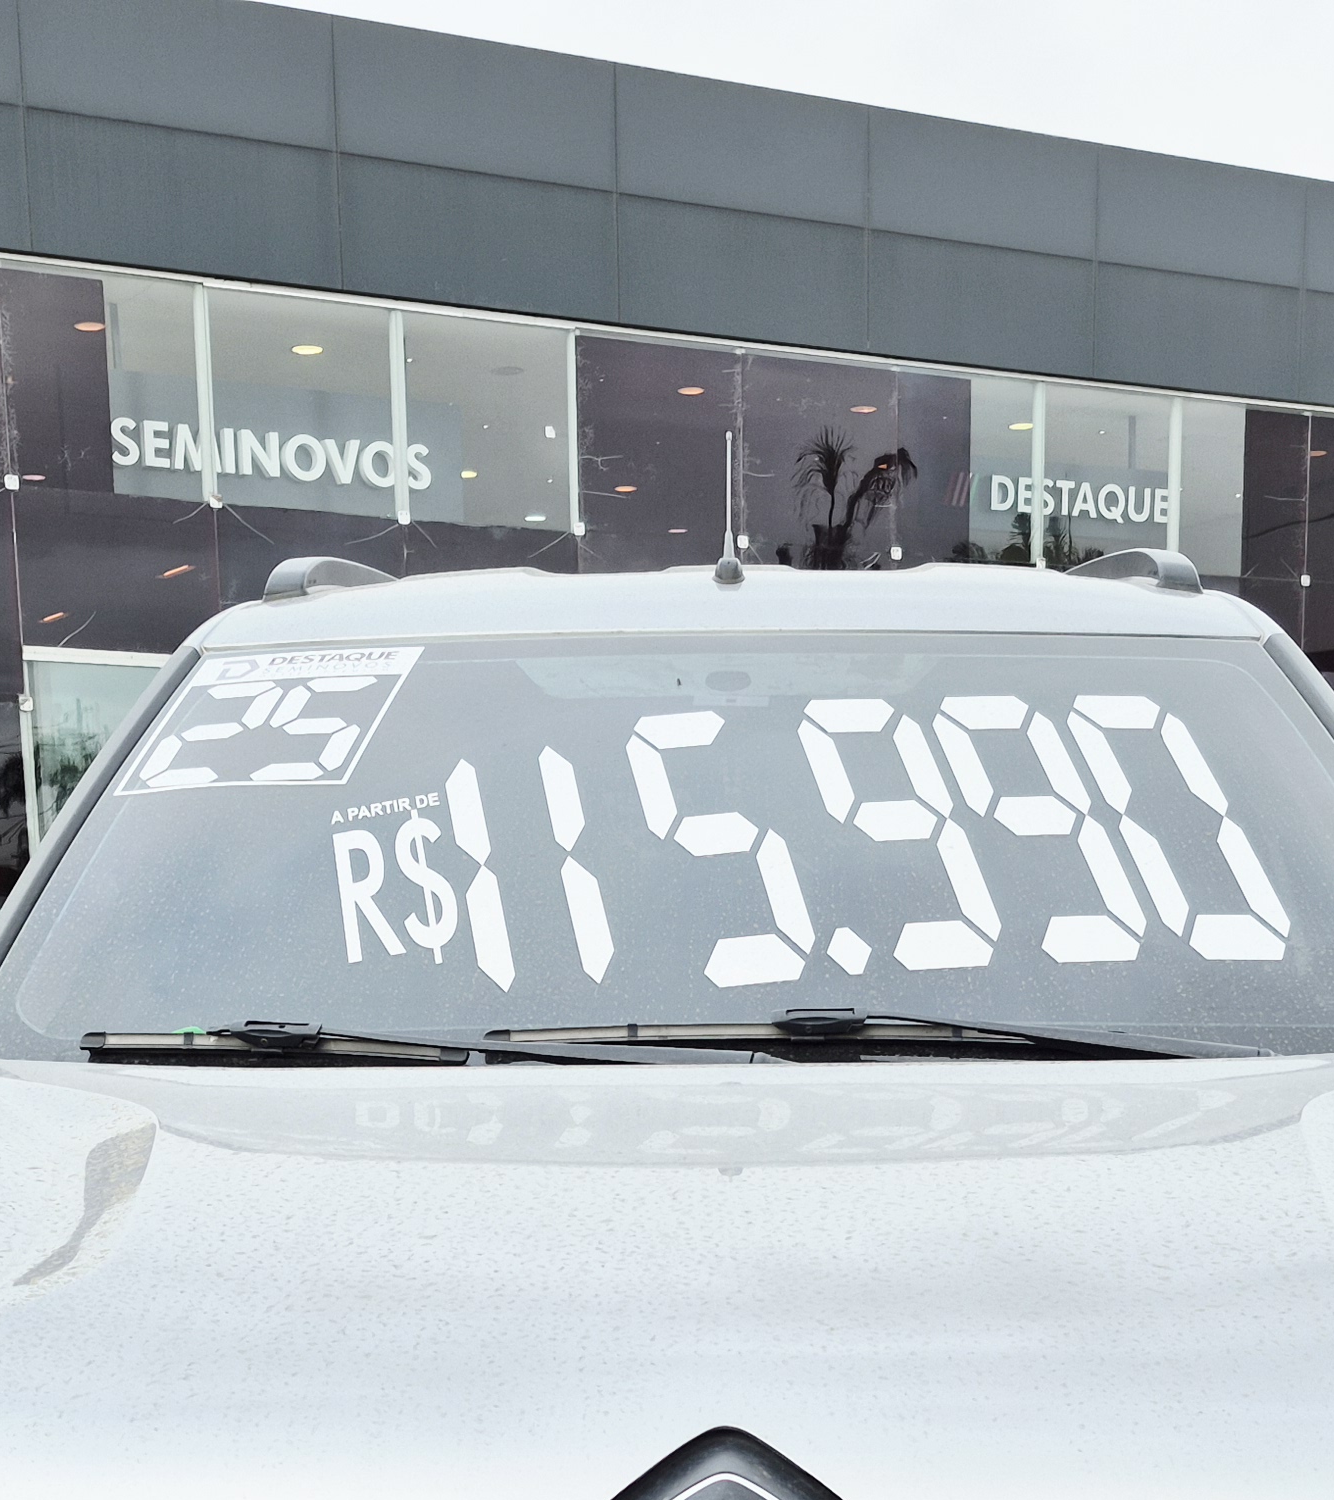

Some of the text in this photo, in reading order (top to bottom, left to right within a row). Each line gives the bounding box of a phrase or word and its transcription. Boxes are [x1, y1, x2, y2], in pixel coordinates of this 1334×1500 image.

[110, 416, 433, 490] SEMINOVOS
[990, 473, 1170, 525] DESTAQUE
[268, 650, 401, 667] DESTAQUE
[139, 675, 379, 788] 25
[330, 792, 441, 825] A PARTIR DE
